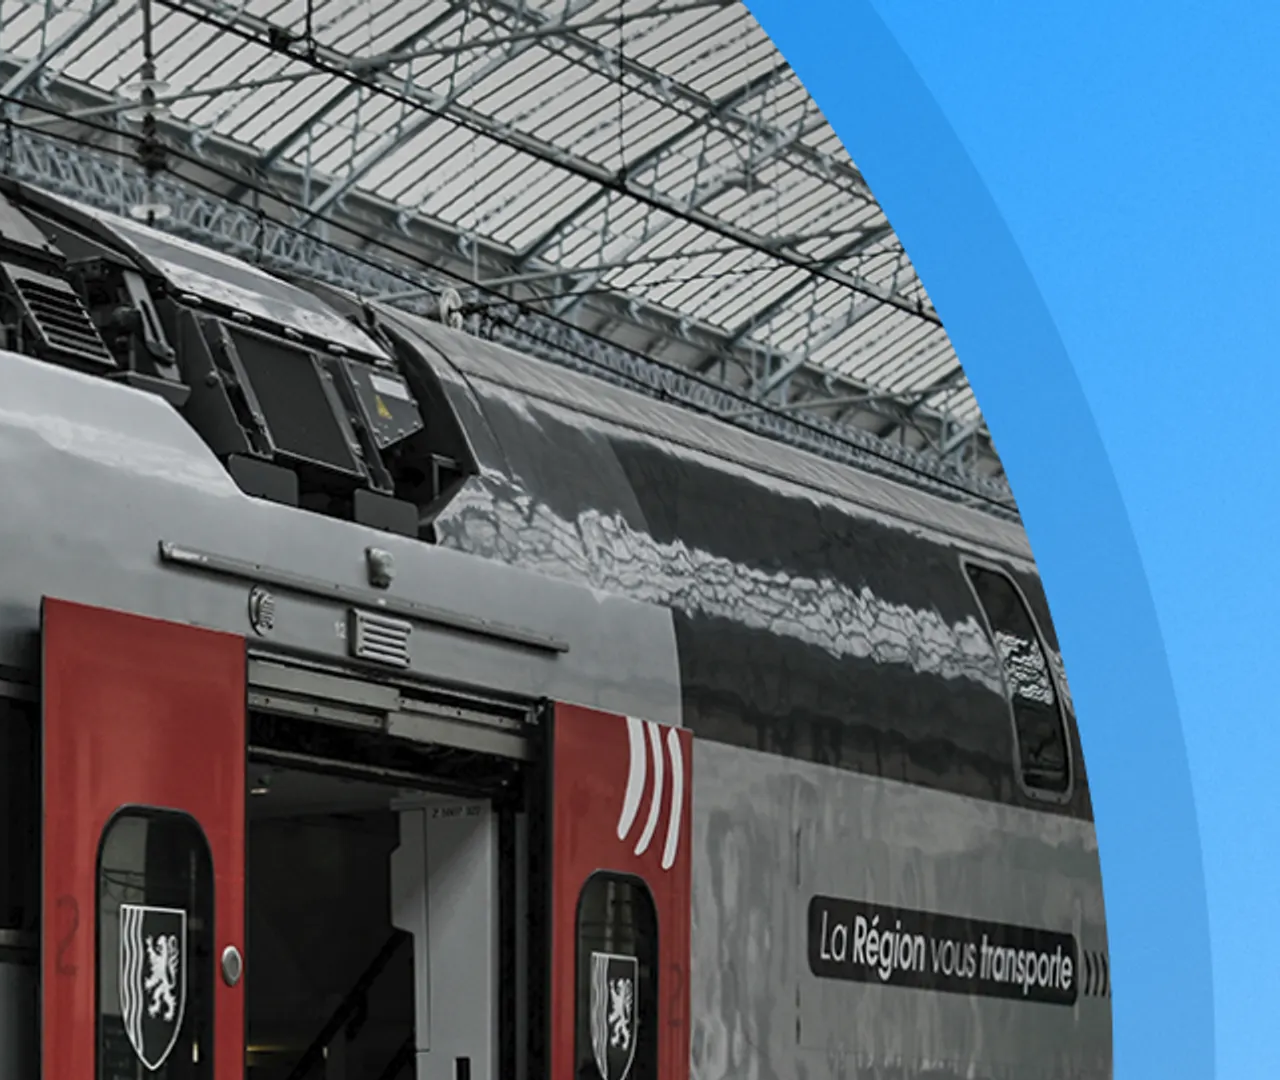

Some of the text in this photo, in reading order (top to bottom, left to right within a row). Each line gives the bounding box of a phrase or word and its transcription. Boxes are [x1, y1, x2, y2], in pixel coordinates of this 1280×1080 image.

[820, 911, 1073, 995] La Région vous transporte
